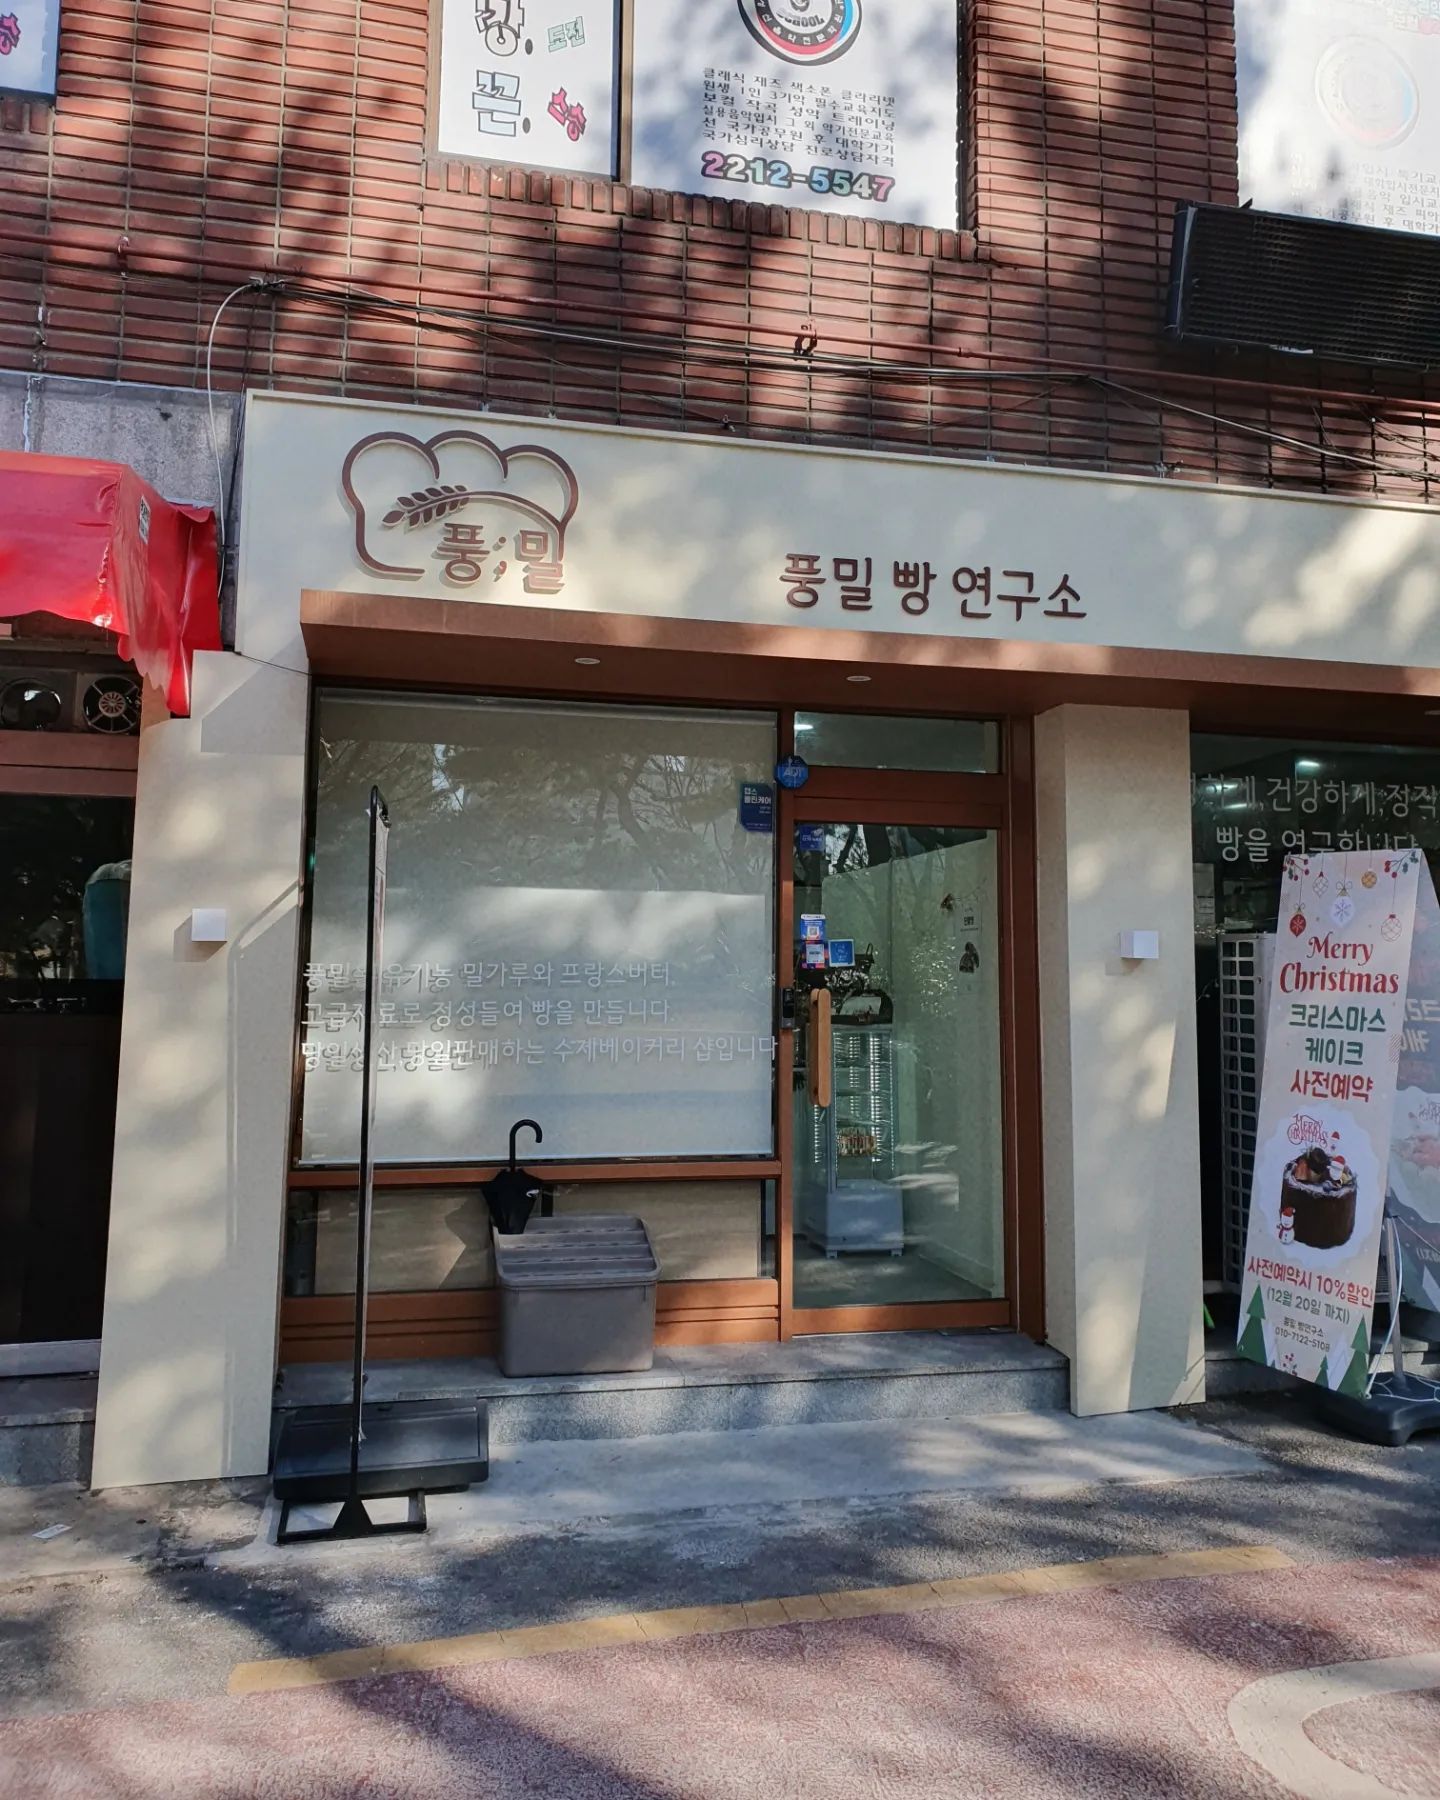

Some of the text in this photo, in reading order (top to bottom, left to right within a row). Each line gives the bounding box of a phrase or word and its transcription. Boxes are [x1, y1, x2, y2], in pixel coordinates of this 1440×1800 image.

[547, 16, 586, 52] 도전
[702, 67, 896, 108] 클래식 재즈 색소폰 클라리넷
[703, 80, 730, 94] 원생
[815, 97, 896, 119] 필수교육지도
[702, 92, 896, 133] 보컬 작곡 성악 트레이닝
[703, 104, 778, 126] 실용음악입시
[785, 117, 796, 128] 그
[822, 122, 895, 144] 악기전문교육
[702, 117, 896, 156] 선 국가공무원 후 대학가기
[702, 129, 896, 167] 국가심리상담 진로상담자격
[701, 150, 896, 202] 2212-5547
[779, 552, 1088, 623] 풍밀 빵 연구소
[1216, 826, 1272, 863] 빵을
[1306, 931, 1374, 967] Merry
[382, 961, 454, 988] 유기농
[463, 960, 555, 988] 밀가루와
[1279, 961, 1399, 994] Christmas
[431, 1000, 525, 1027] 정성들여
[532, 999, 576, 1026] 빵을
[1288, 1003, 1387, 1033] 크리스마스
[553, 1036, 685, 1064] 수제베이커리
[1305, 1036, 1364, 1066] 케이크
[1290, 1068, 1374, 1104] 사전예약
[1247, 1255, 1313, 1291] 사전예약시
[1266, 1285, 1350, 1325] (12월 20일 까지)
